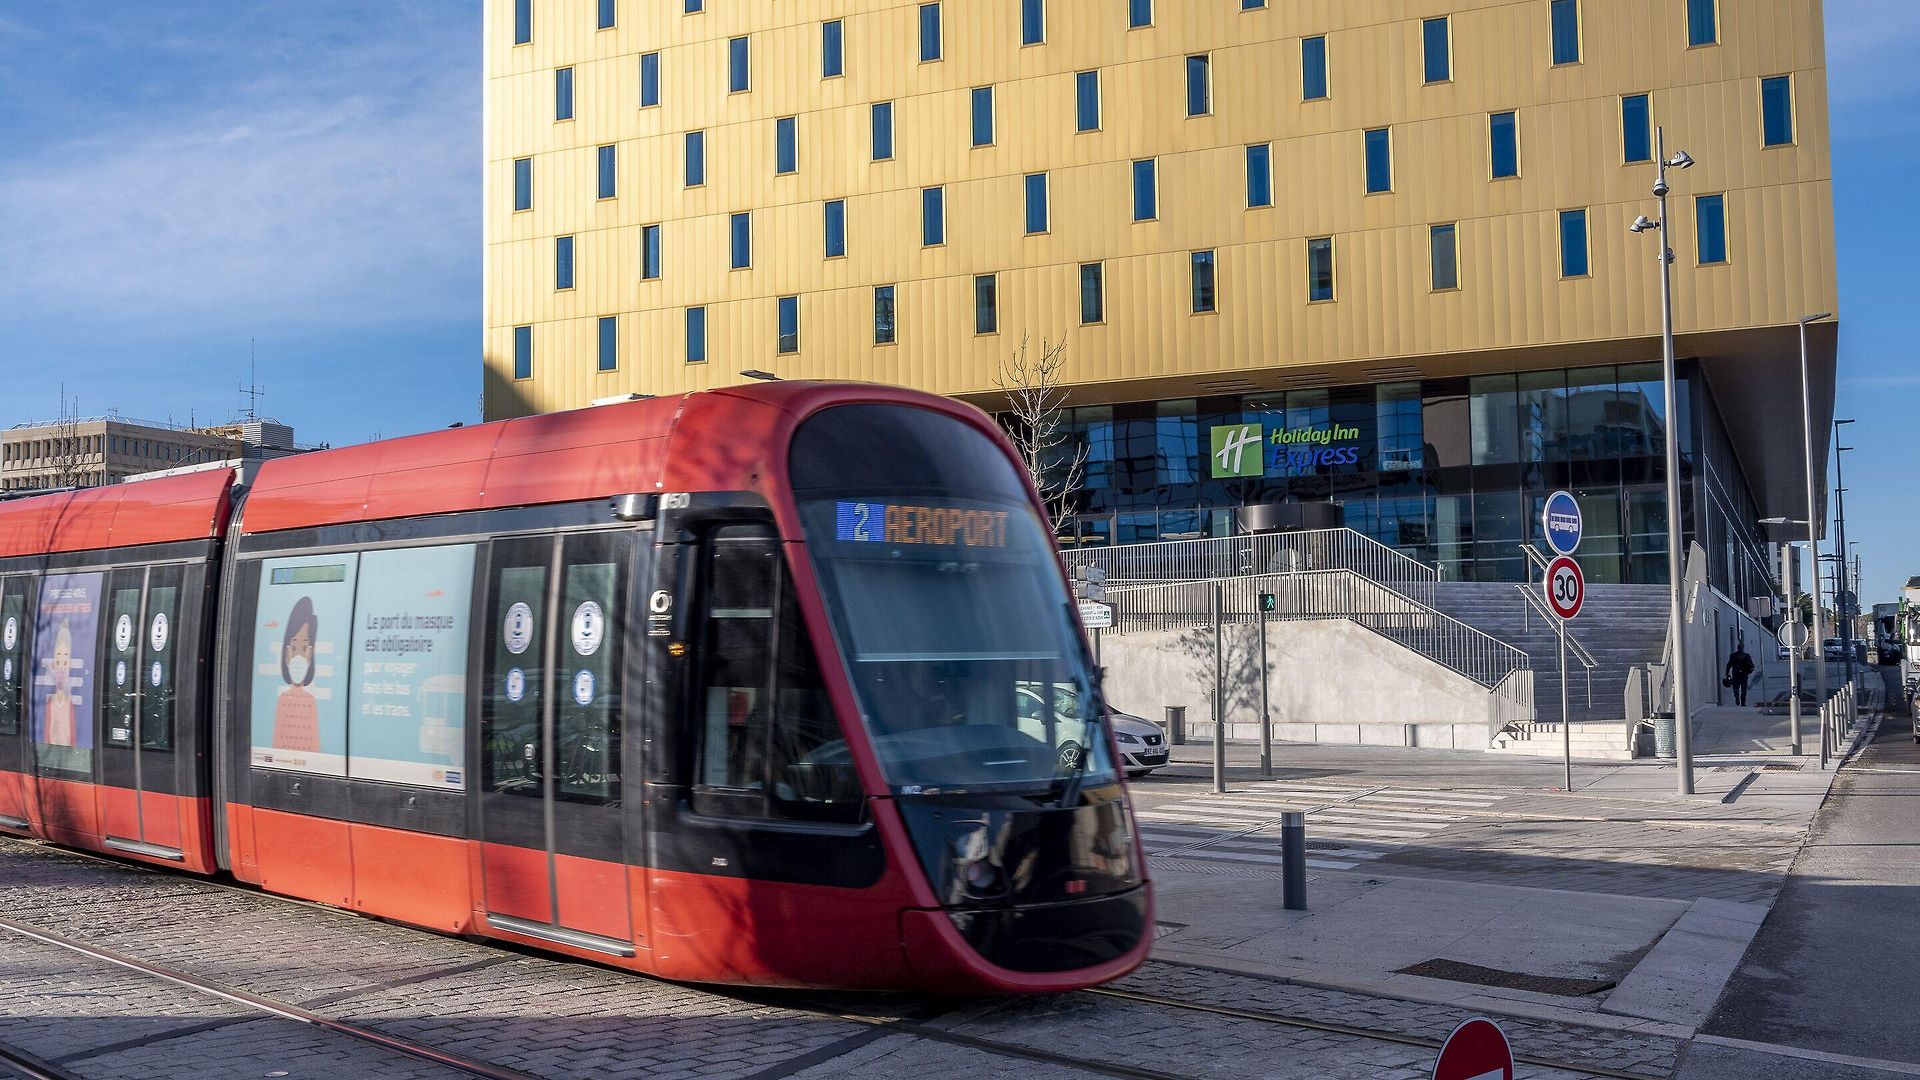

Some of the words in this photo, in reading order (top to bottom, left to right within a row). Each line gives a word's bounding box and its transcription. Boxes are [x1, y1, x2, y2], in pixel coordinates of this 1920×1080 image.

[1270, 427, 1331, 445] Holiday
[1333, 424, 1360, 441] Inn
[1271, 446, 1360, 473] Express
[853, 503, 869, 541] 2
[884, 505, 1009, 547] AEROPORT
[1554, 574, 1577, 602] 30
[366, 613, 378, 630] Le
[379, 613, 400, 634] port
[402, 612, 413, 630] du
[415, 615, 454, 634] masque
[366, 636, 380, 652] est
[381, 635, 433, 656] obligatoire
